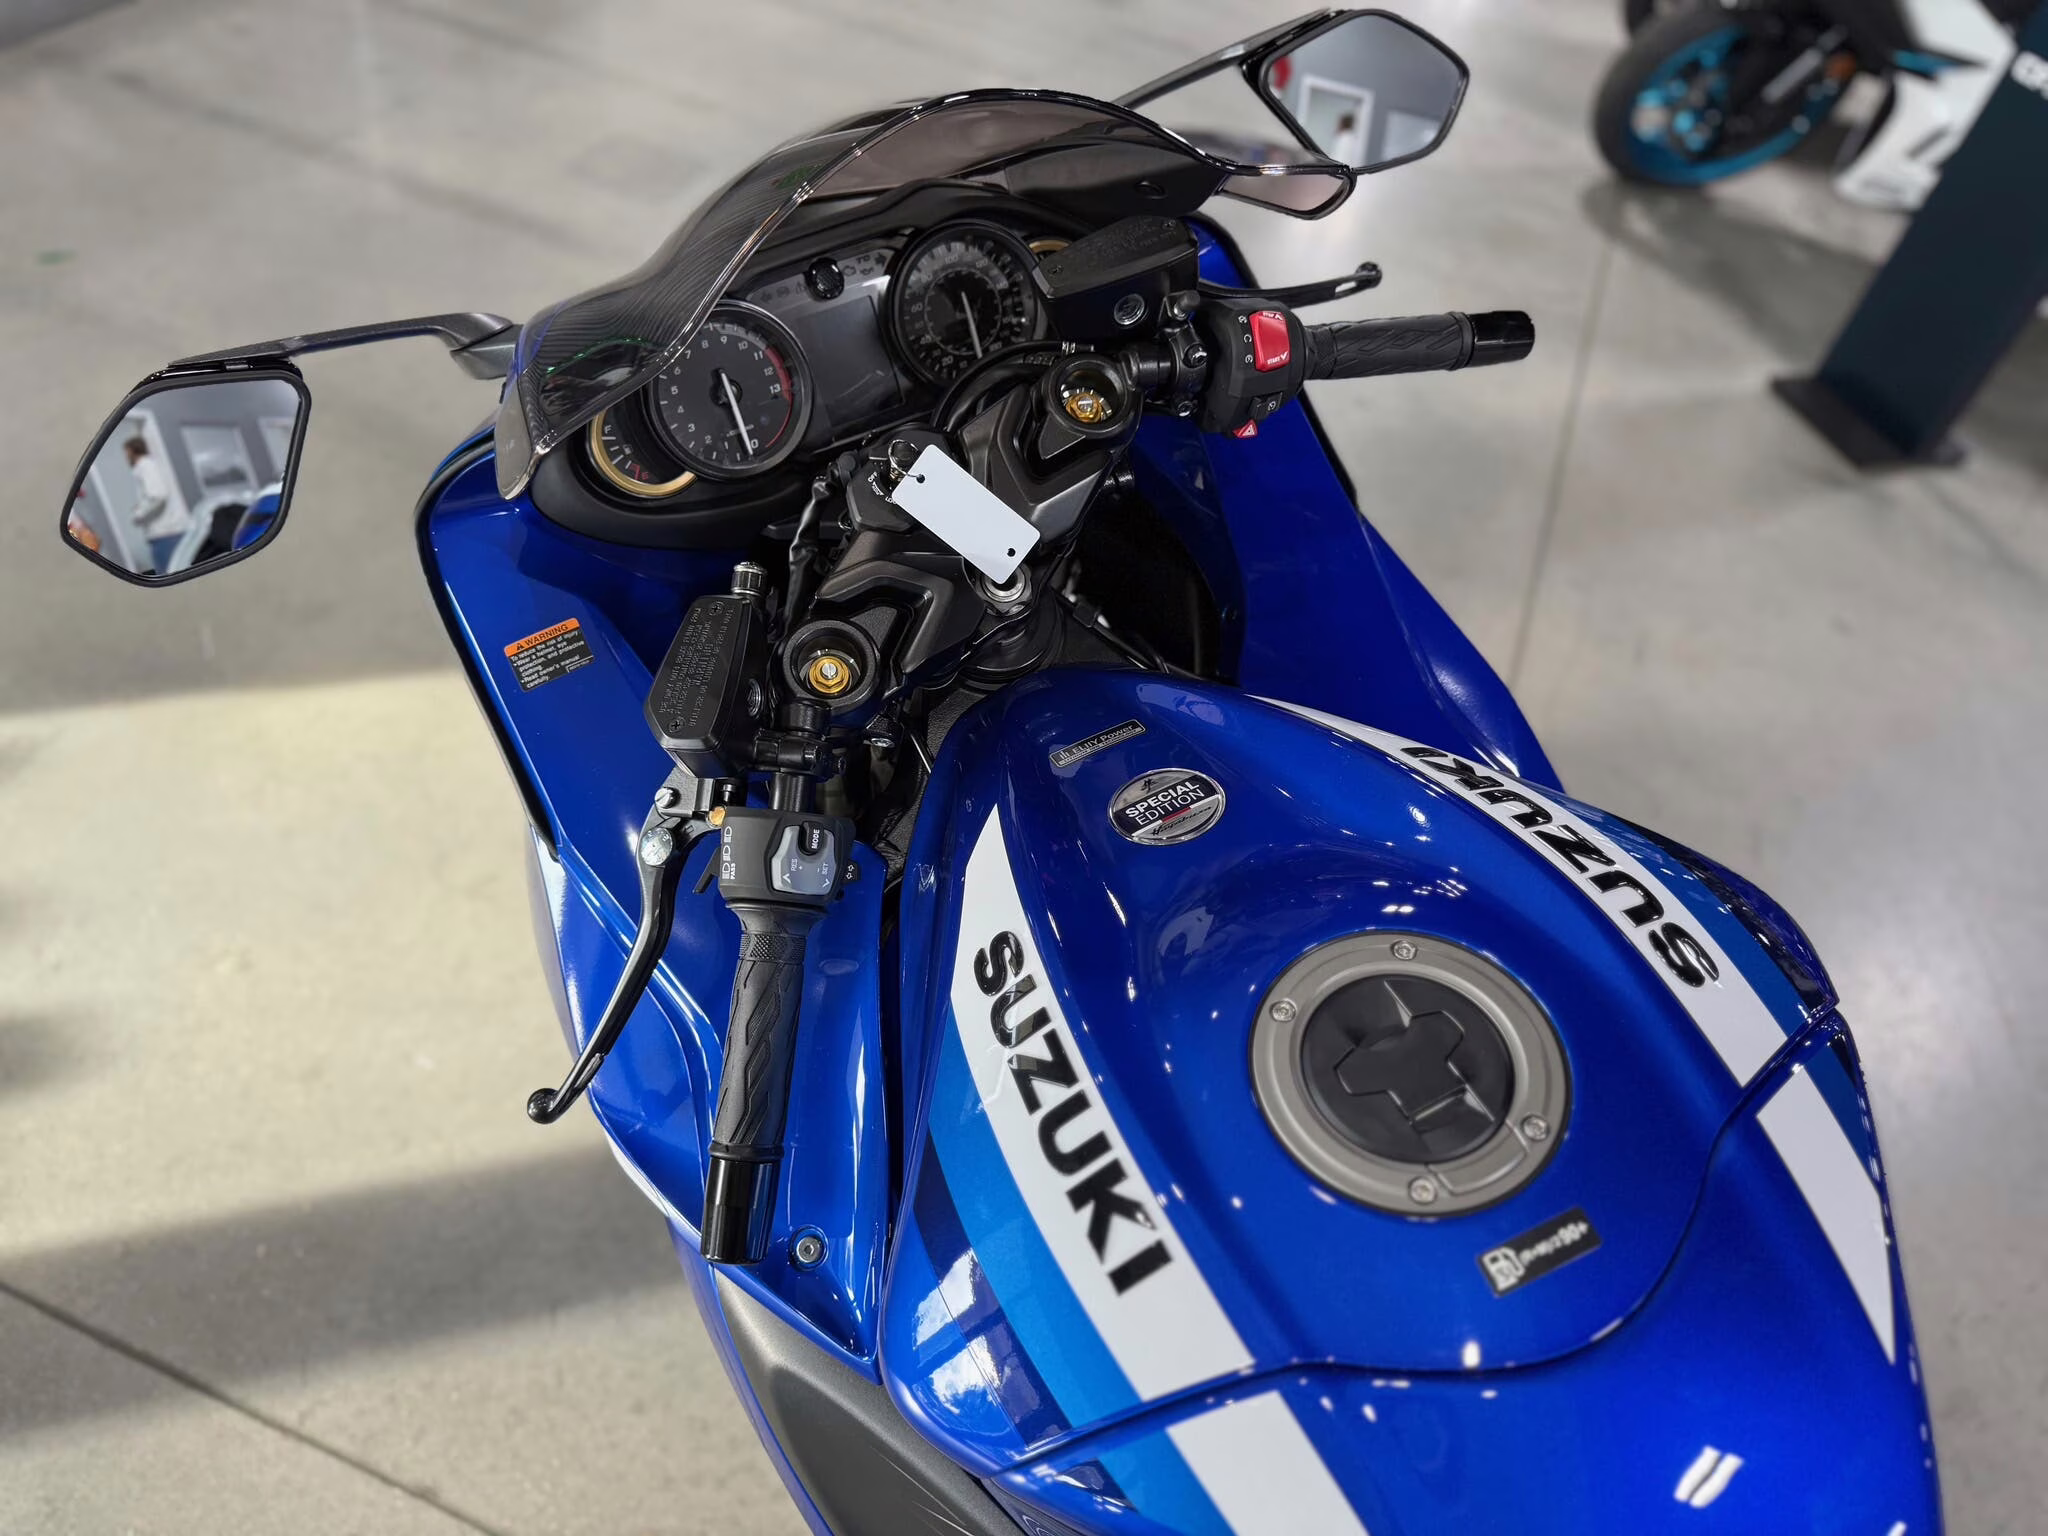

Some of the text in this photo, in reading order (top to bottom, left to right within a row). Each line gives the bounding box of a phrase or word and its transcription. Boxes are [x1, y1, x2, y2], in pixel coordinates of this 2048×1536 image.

[702, 340, 709, 348] 8
[720, 336, 728, 344] 9
[738, 341, 748, 350] 10
[685, 350, 692, 359] 7
[754, 352, 764, 360] 11
[674, 366, 681, 375] 6
[764, 368, 774, 376] 12
[671, 386, 678, 394] 5
[770, 384, 781, 394] 13
[678, 406, 684, 414] 4
[604, 424, 612, 435] F
[688, 424, 696, 432] 3
[704, 436, 712, 444] 2
[750, 439, 759, 449] 0
[524, 622, 568, 646] WARNING
[1100, 724, 1135, 742] Power
[1125, 780, 1200, 818] SPECIAL
[1134, 788, 1205, 826] EDITION
[811, 828, 820, 850] MODE
[1400, 747, 1719, 987] SUZUKI
[974, 931, 1174, 1296] SUZUKI
